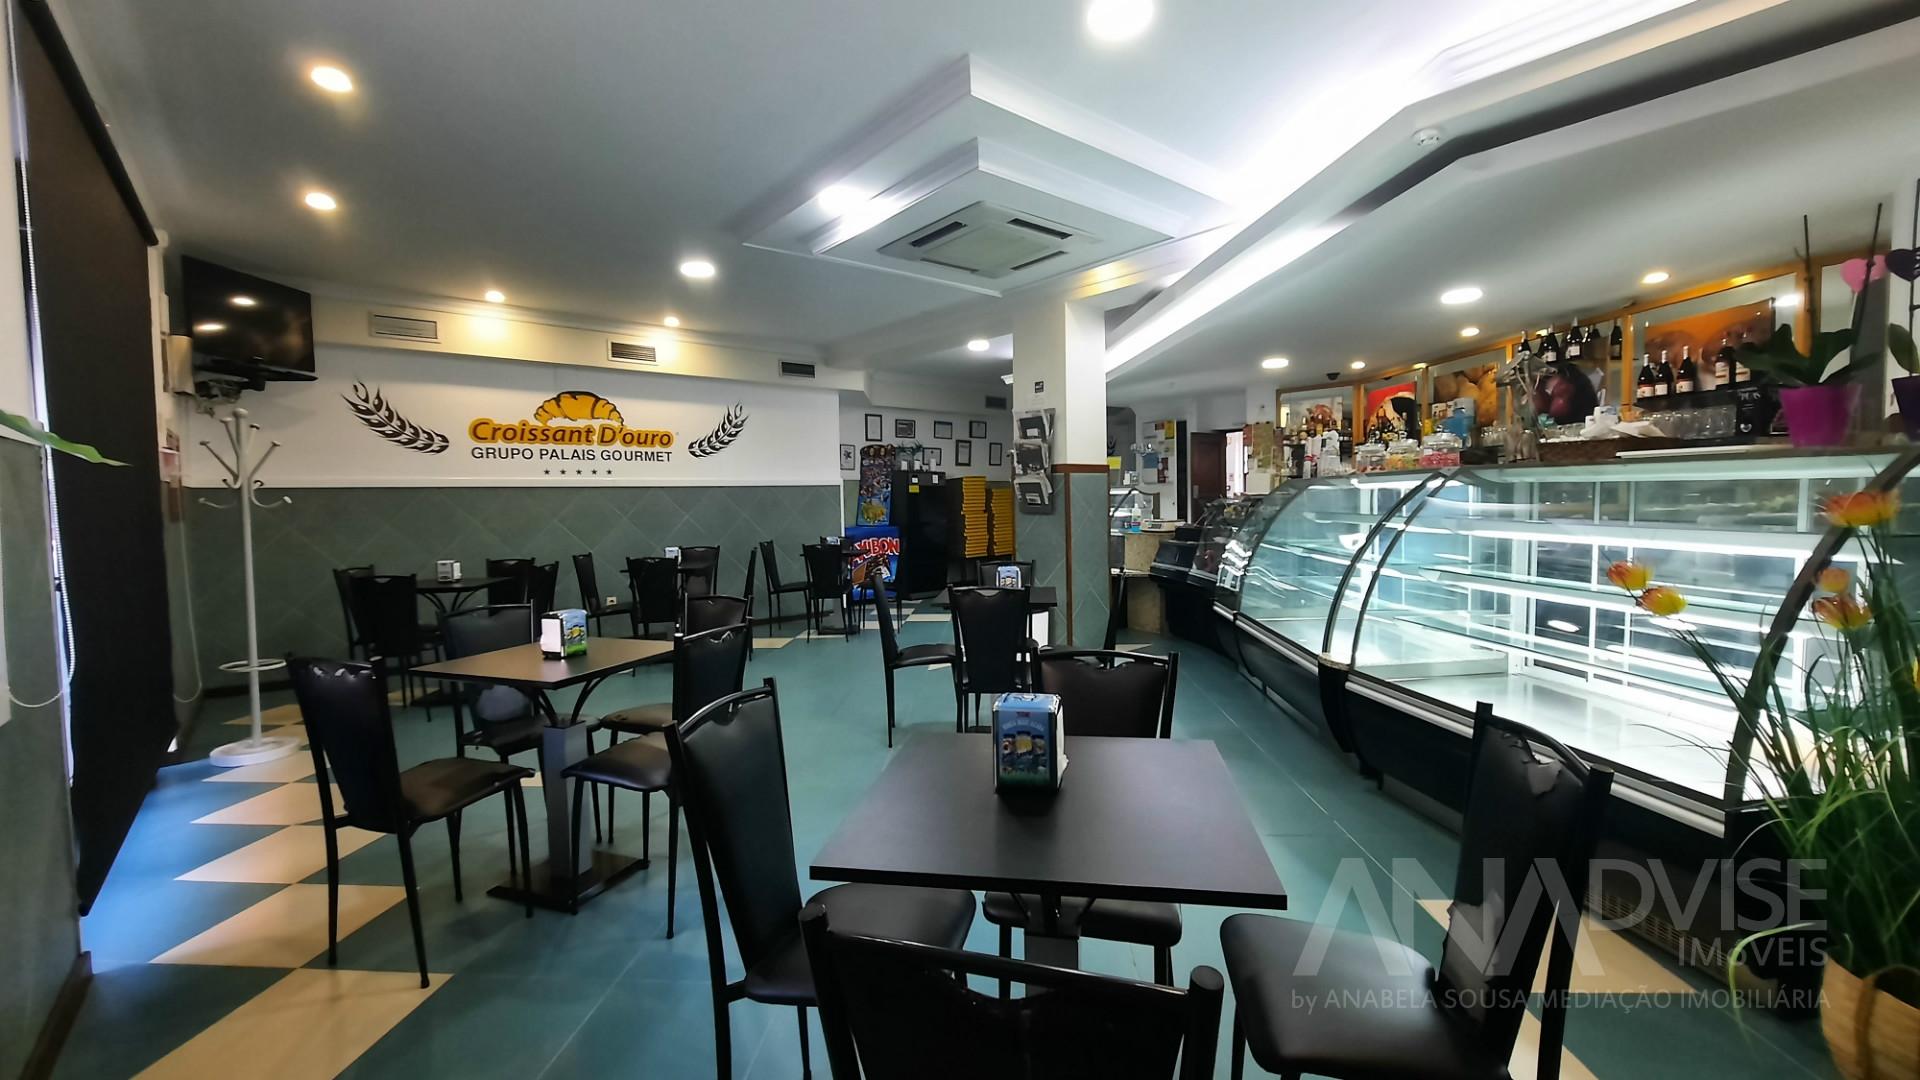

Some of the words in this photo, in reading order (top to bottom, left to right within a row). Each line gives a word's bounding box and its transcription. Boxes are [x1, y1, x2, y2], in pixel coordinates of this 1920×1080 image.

[472, 421, 593, 443] Croissant
[600, 426, 672, 446] D'ouro
[471, 446, 534, 460] GRUPO
[539, 448, 596, 461] PALAIS
[600, 449, 673, 462] GOURMET
